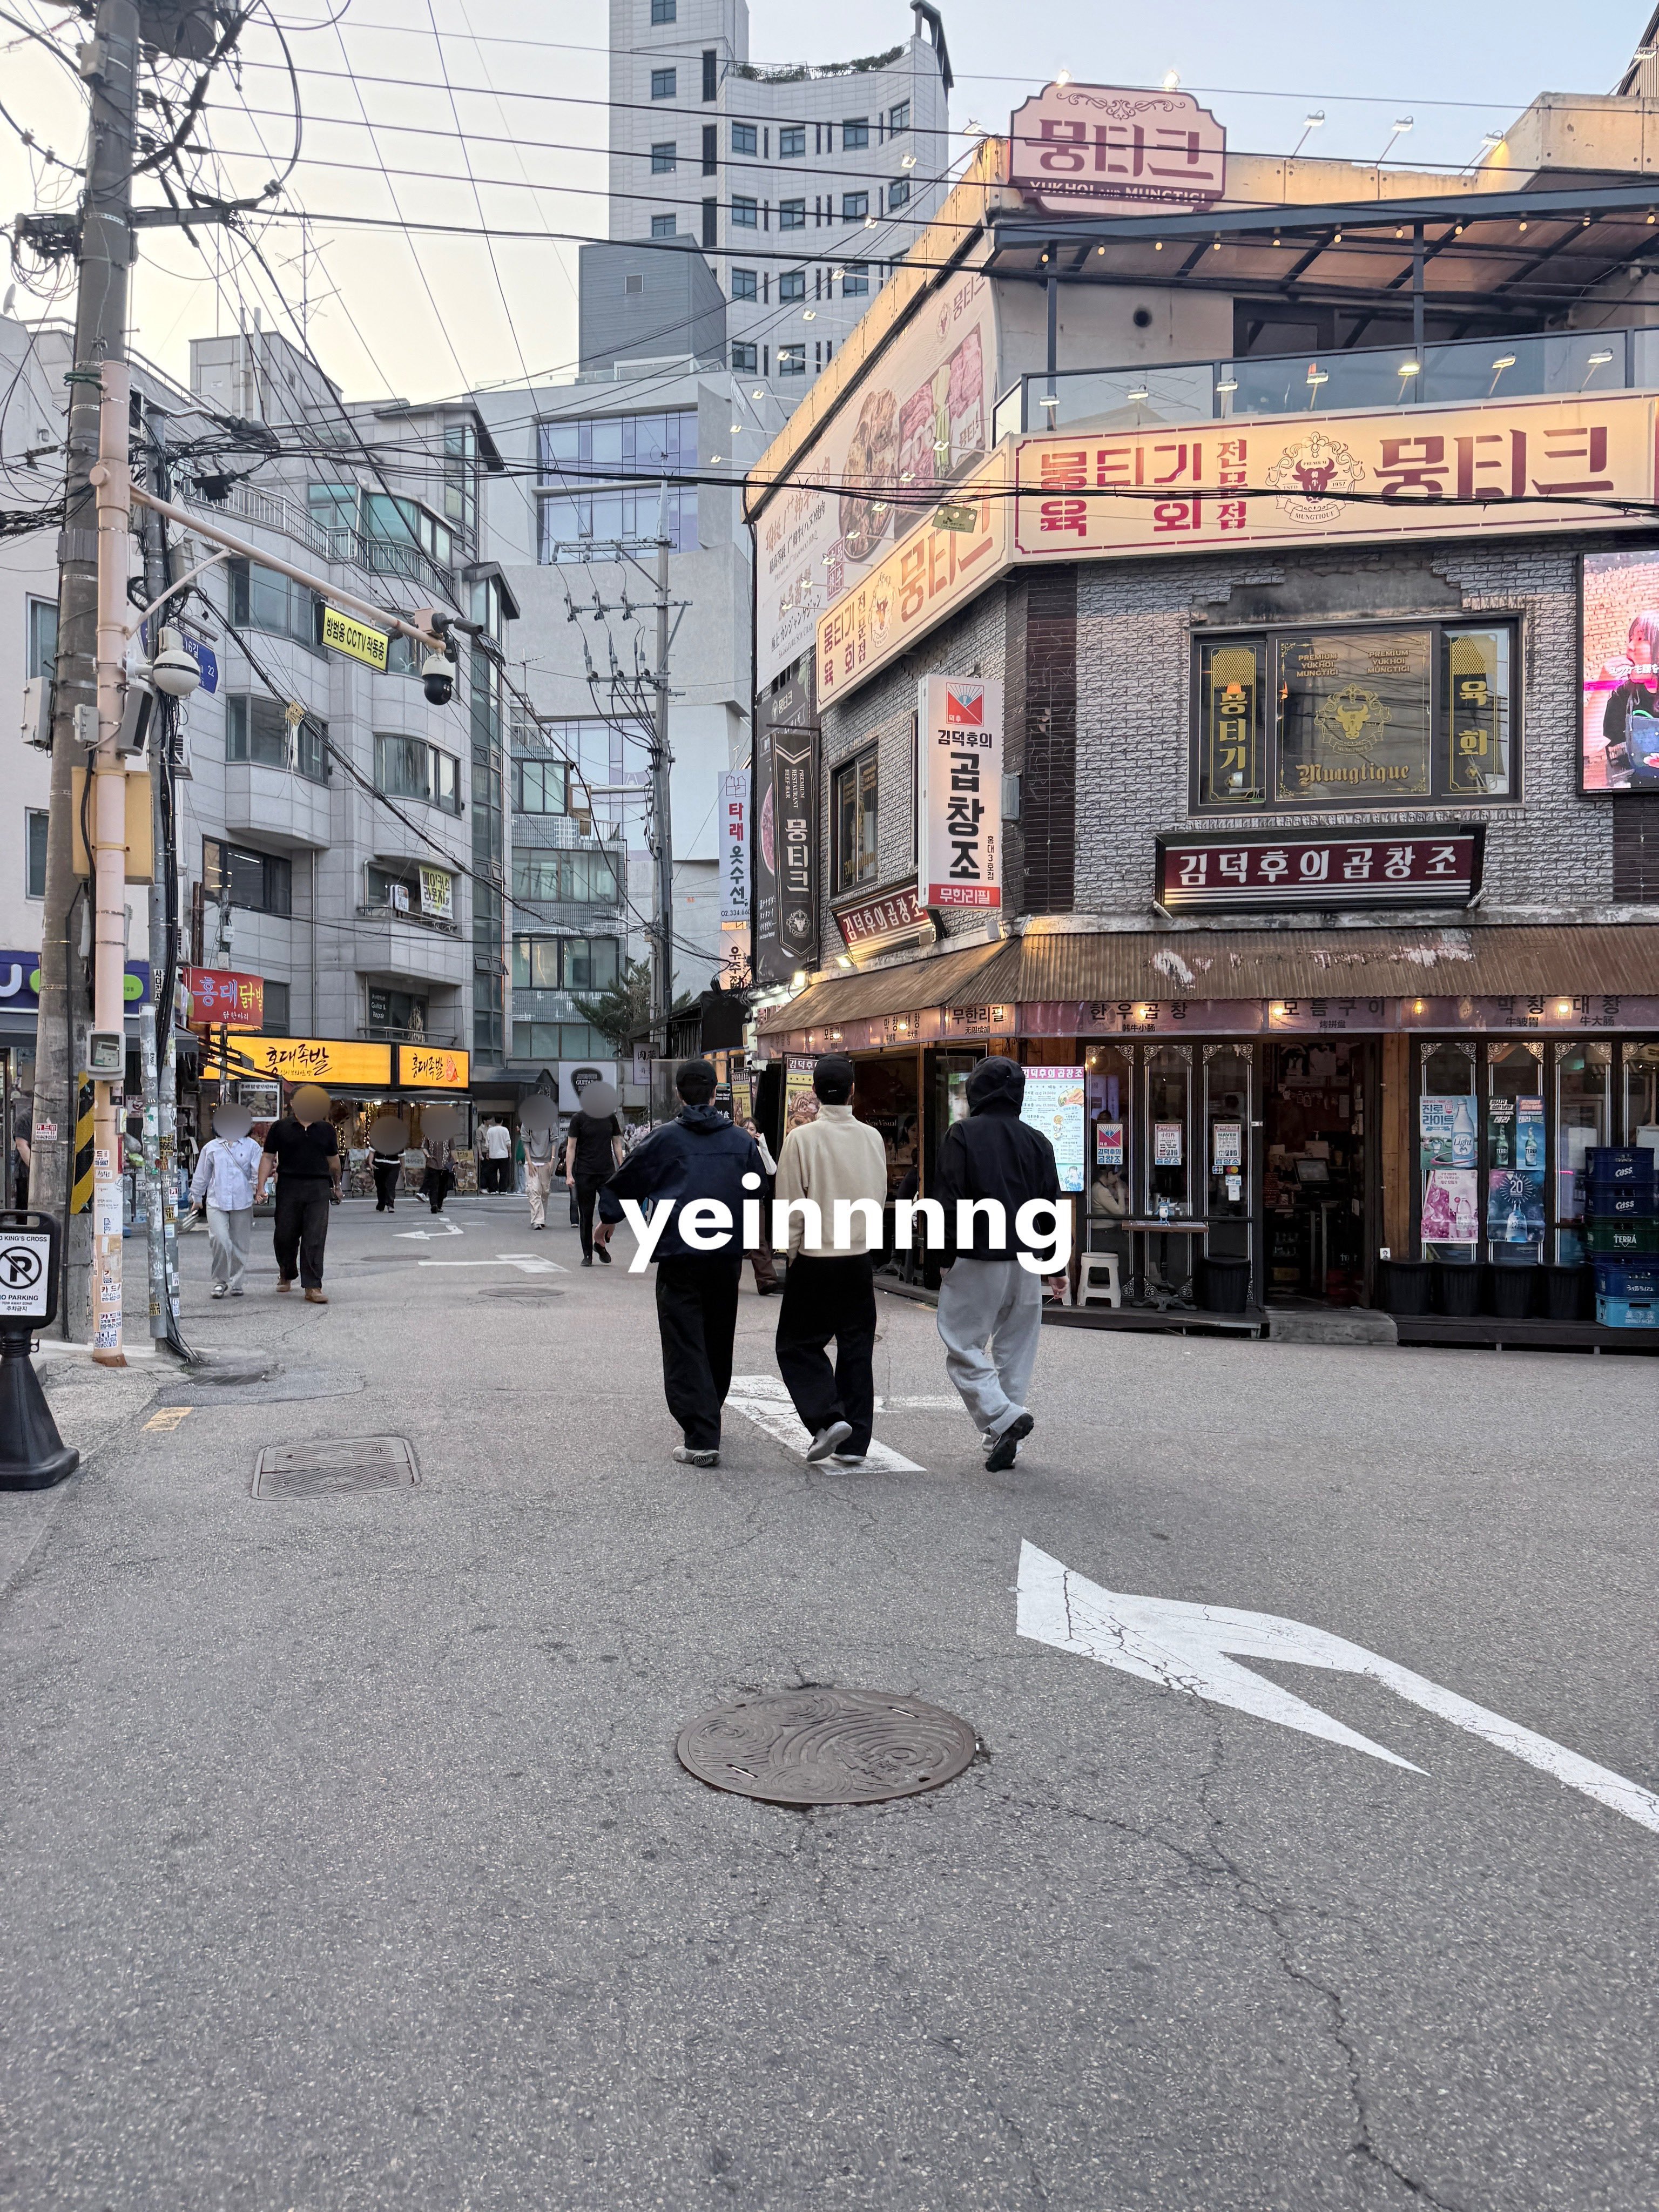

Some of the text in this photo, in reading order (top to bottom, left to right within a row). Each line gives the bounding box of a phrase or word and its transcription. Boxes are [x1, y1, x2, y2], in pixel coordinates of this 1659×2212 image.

[1025, 118, 1214, 181] 뭉티크
[1029, 180, 1095, 198] YUKHOI
[1041, 443, 1202, 491] 뭉티기
[1373, 426, 1614, 506] 뭉티크
[1216, 439, 1247, 531] 전문점
[327, 616, 385, 661] 방범용 CCTV 작동중
[1298, 651, 1339, 661] PREMIUM
[1368, 649, 1410, 657] PREMIUM
[1371, 657, 1406, 666] YUKHOI
[205, 664, 214, 678] 22
[1301, 660, 1334, 669] YUKHOI
[938, 729, 993, 749] 김덕후의
[1296, 763, 1410, 786] Mungtique
[728, 802, 744, 842] 타래
[946, 751, 985, 880] 곱창조
[785, 818, 810, 893] 뭉티크
[1178, 844, 1457, 886] 김덕후의 곱창조
[728, 845, 746, 905] 옷수선
[940, 887, 990, 905] 무한리필
[842, 905, 888, 941] 김덕후의
[192, 976, 264, 1013] 홍대닭발
[1090, 1002, 1188, 1020] 한우곱창
[1498, 996, 1621, 1015] 막창 대창
[952, 1006, 1004, 1024] 무한리필
[265, 1043, 333, 1076] 홍대족발
[412, 1053, 444, 1081] 홍대족발
[790, 1059, 817, 1070] 김덕후
[1057, 1068, 1083, 1078] 곱창조
[1422, 1104, 1444, 1115] 진로
[1422, 1115, 1454, 1125] 라이트
[1454, 1137, 1472, 1148] Light
[1615, 1166, 1633, 1177] Cass
[1510, 1179, 1523, 1193] 20
[1615, 1201, 1634, 1210] Cass
[1614, 1235, 1637, 1244] TERRA
